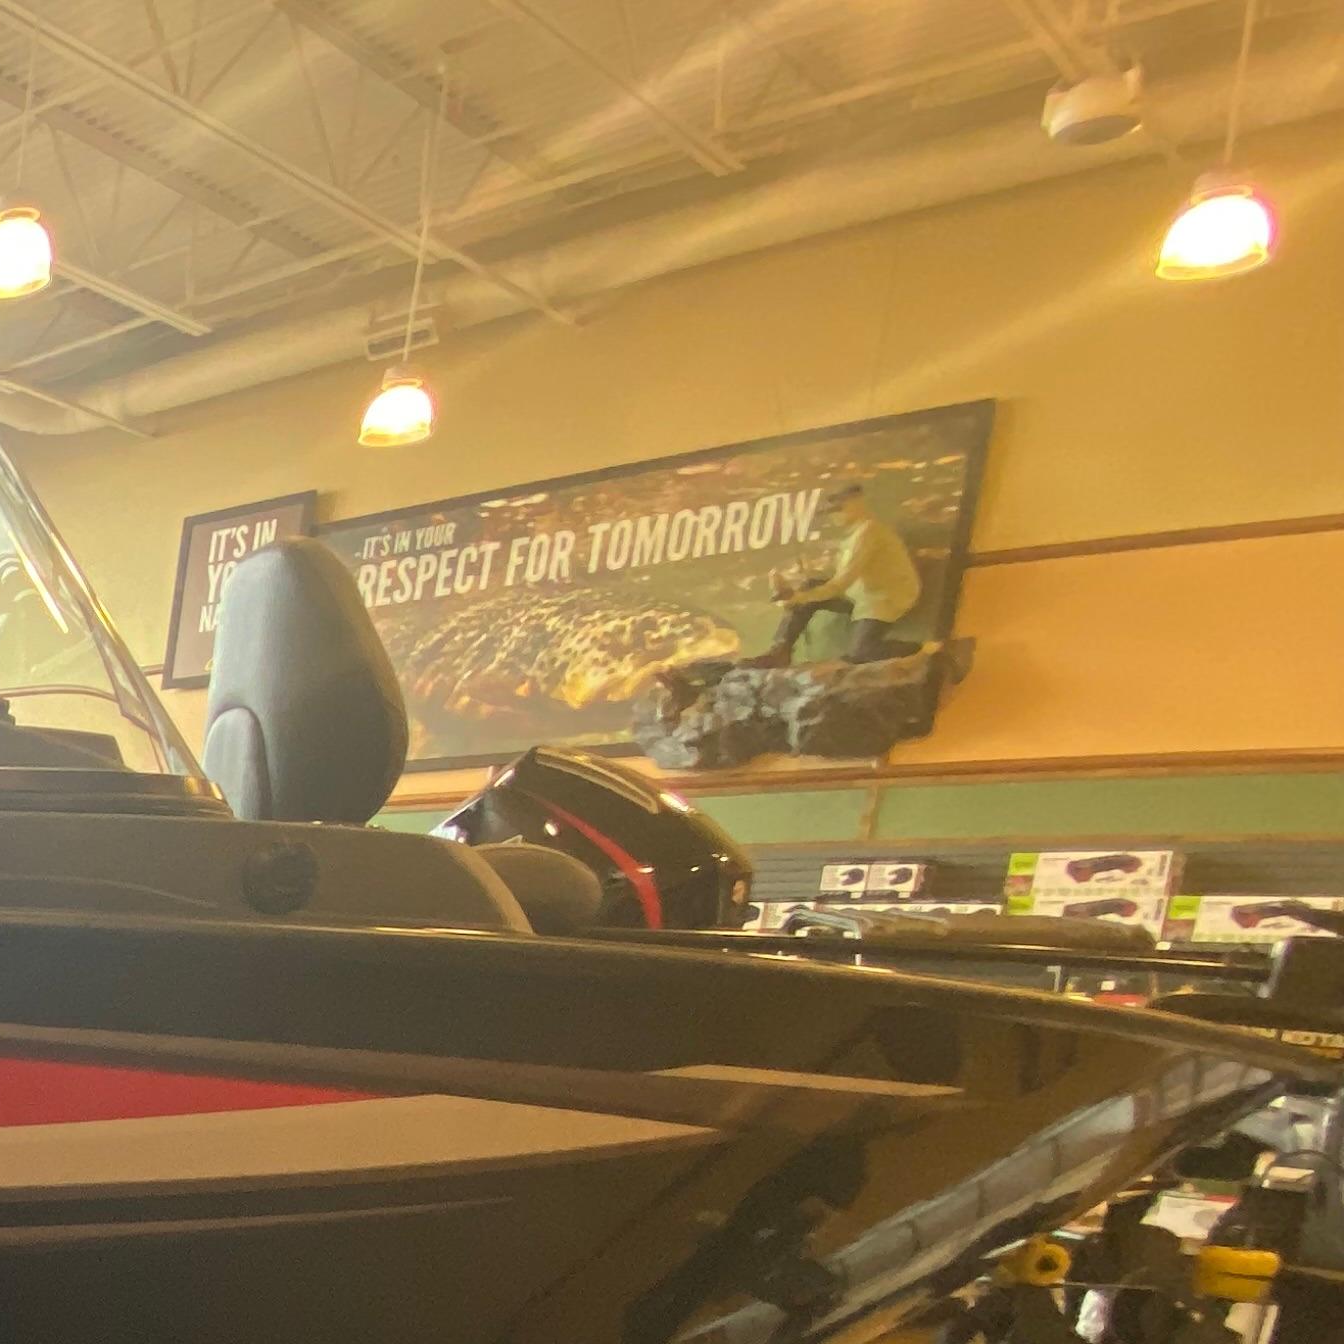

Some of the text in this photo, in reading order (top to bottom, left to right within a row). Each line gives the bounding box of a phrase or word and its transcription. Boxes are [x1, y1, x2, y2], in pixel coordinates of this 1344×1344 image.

[209, 519, 277, 562] IT'S IN
[358, 488, 824, 609] RESPECT FOR TOMORROW.
[393, 530, 412, 555] IN
[415, 522, 457, 551] YOUR
